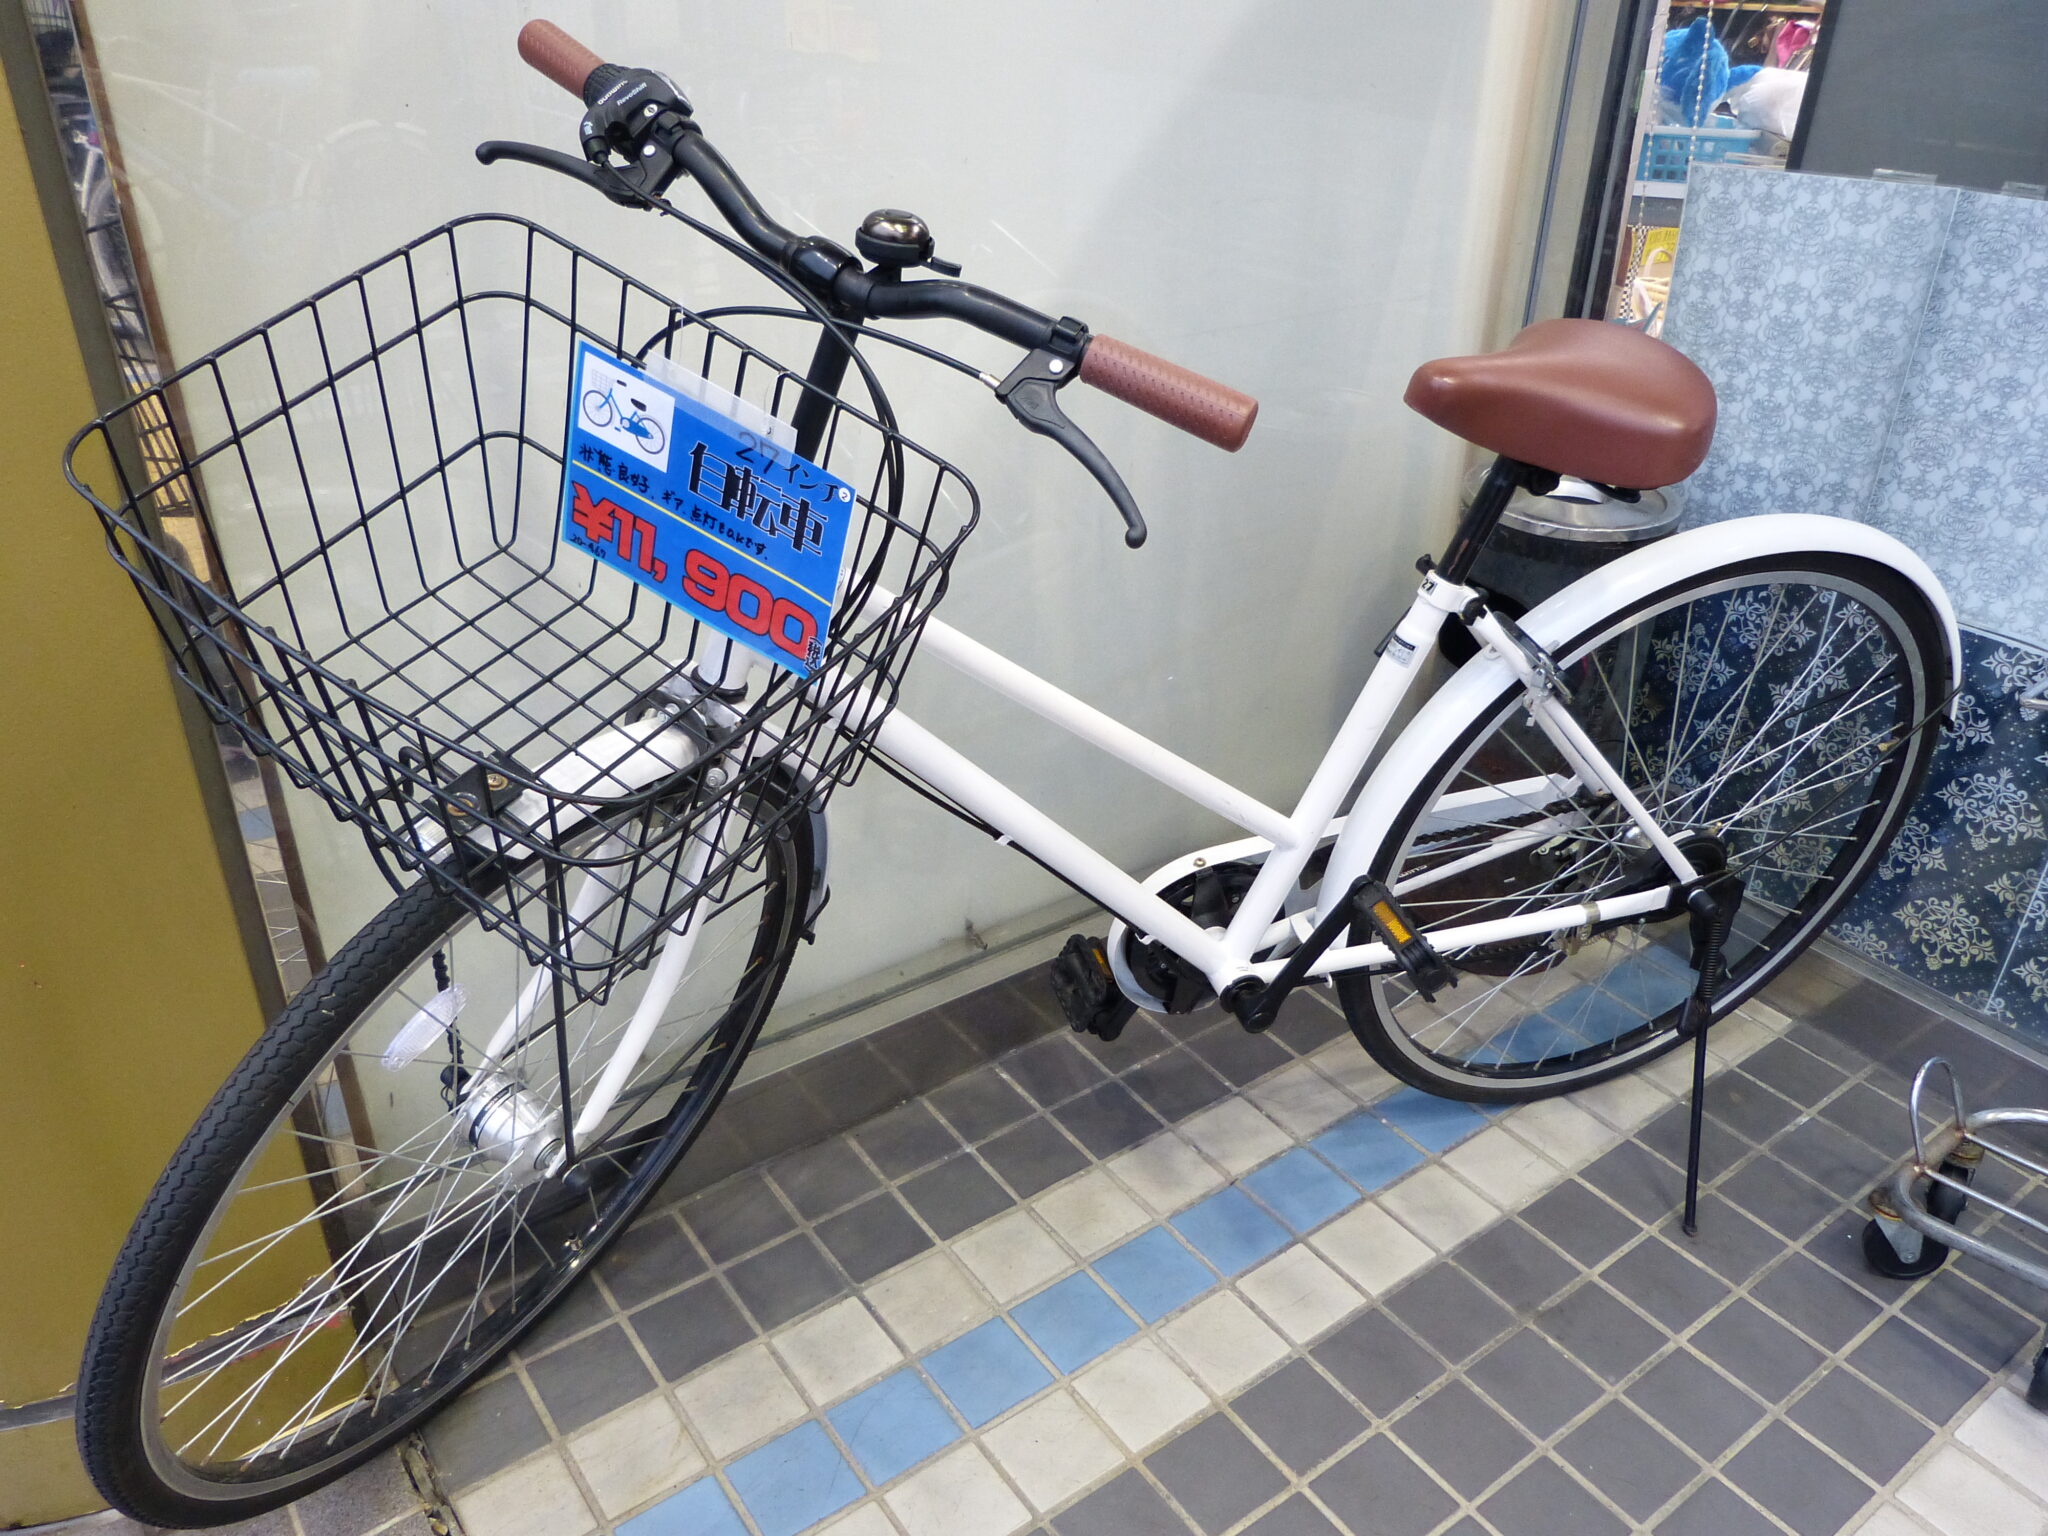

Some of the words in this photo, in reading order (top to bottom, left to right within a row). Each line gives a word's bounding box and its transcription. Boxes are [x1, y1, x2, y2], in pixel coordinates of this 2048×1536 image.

[688, 440, 829, 557] 自転車
[1421, 577, 1435, 592] 27
